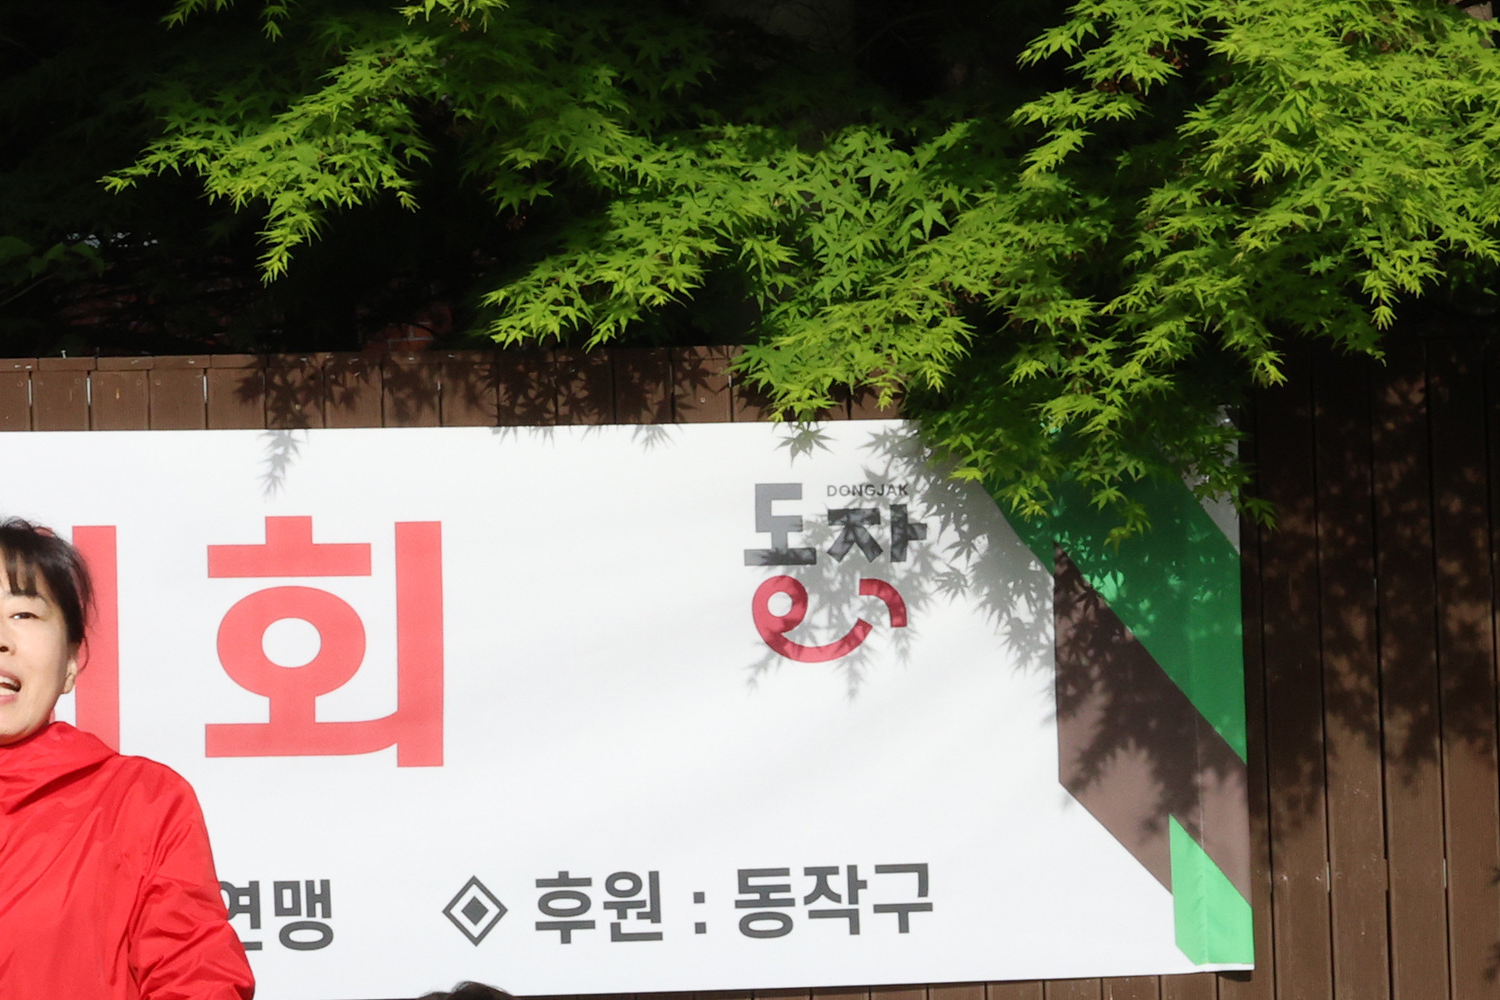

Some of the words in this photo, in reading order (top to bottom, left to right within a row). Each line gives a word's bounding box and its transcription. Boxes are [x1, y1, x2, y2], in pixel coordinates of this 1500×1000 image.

[827, 484, 909, 497] DONGJAK
[535, 870, 664, 944] 후원
[734, 863, 934, 939] 동작구
